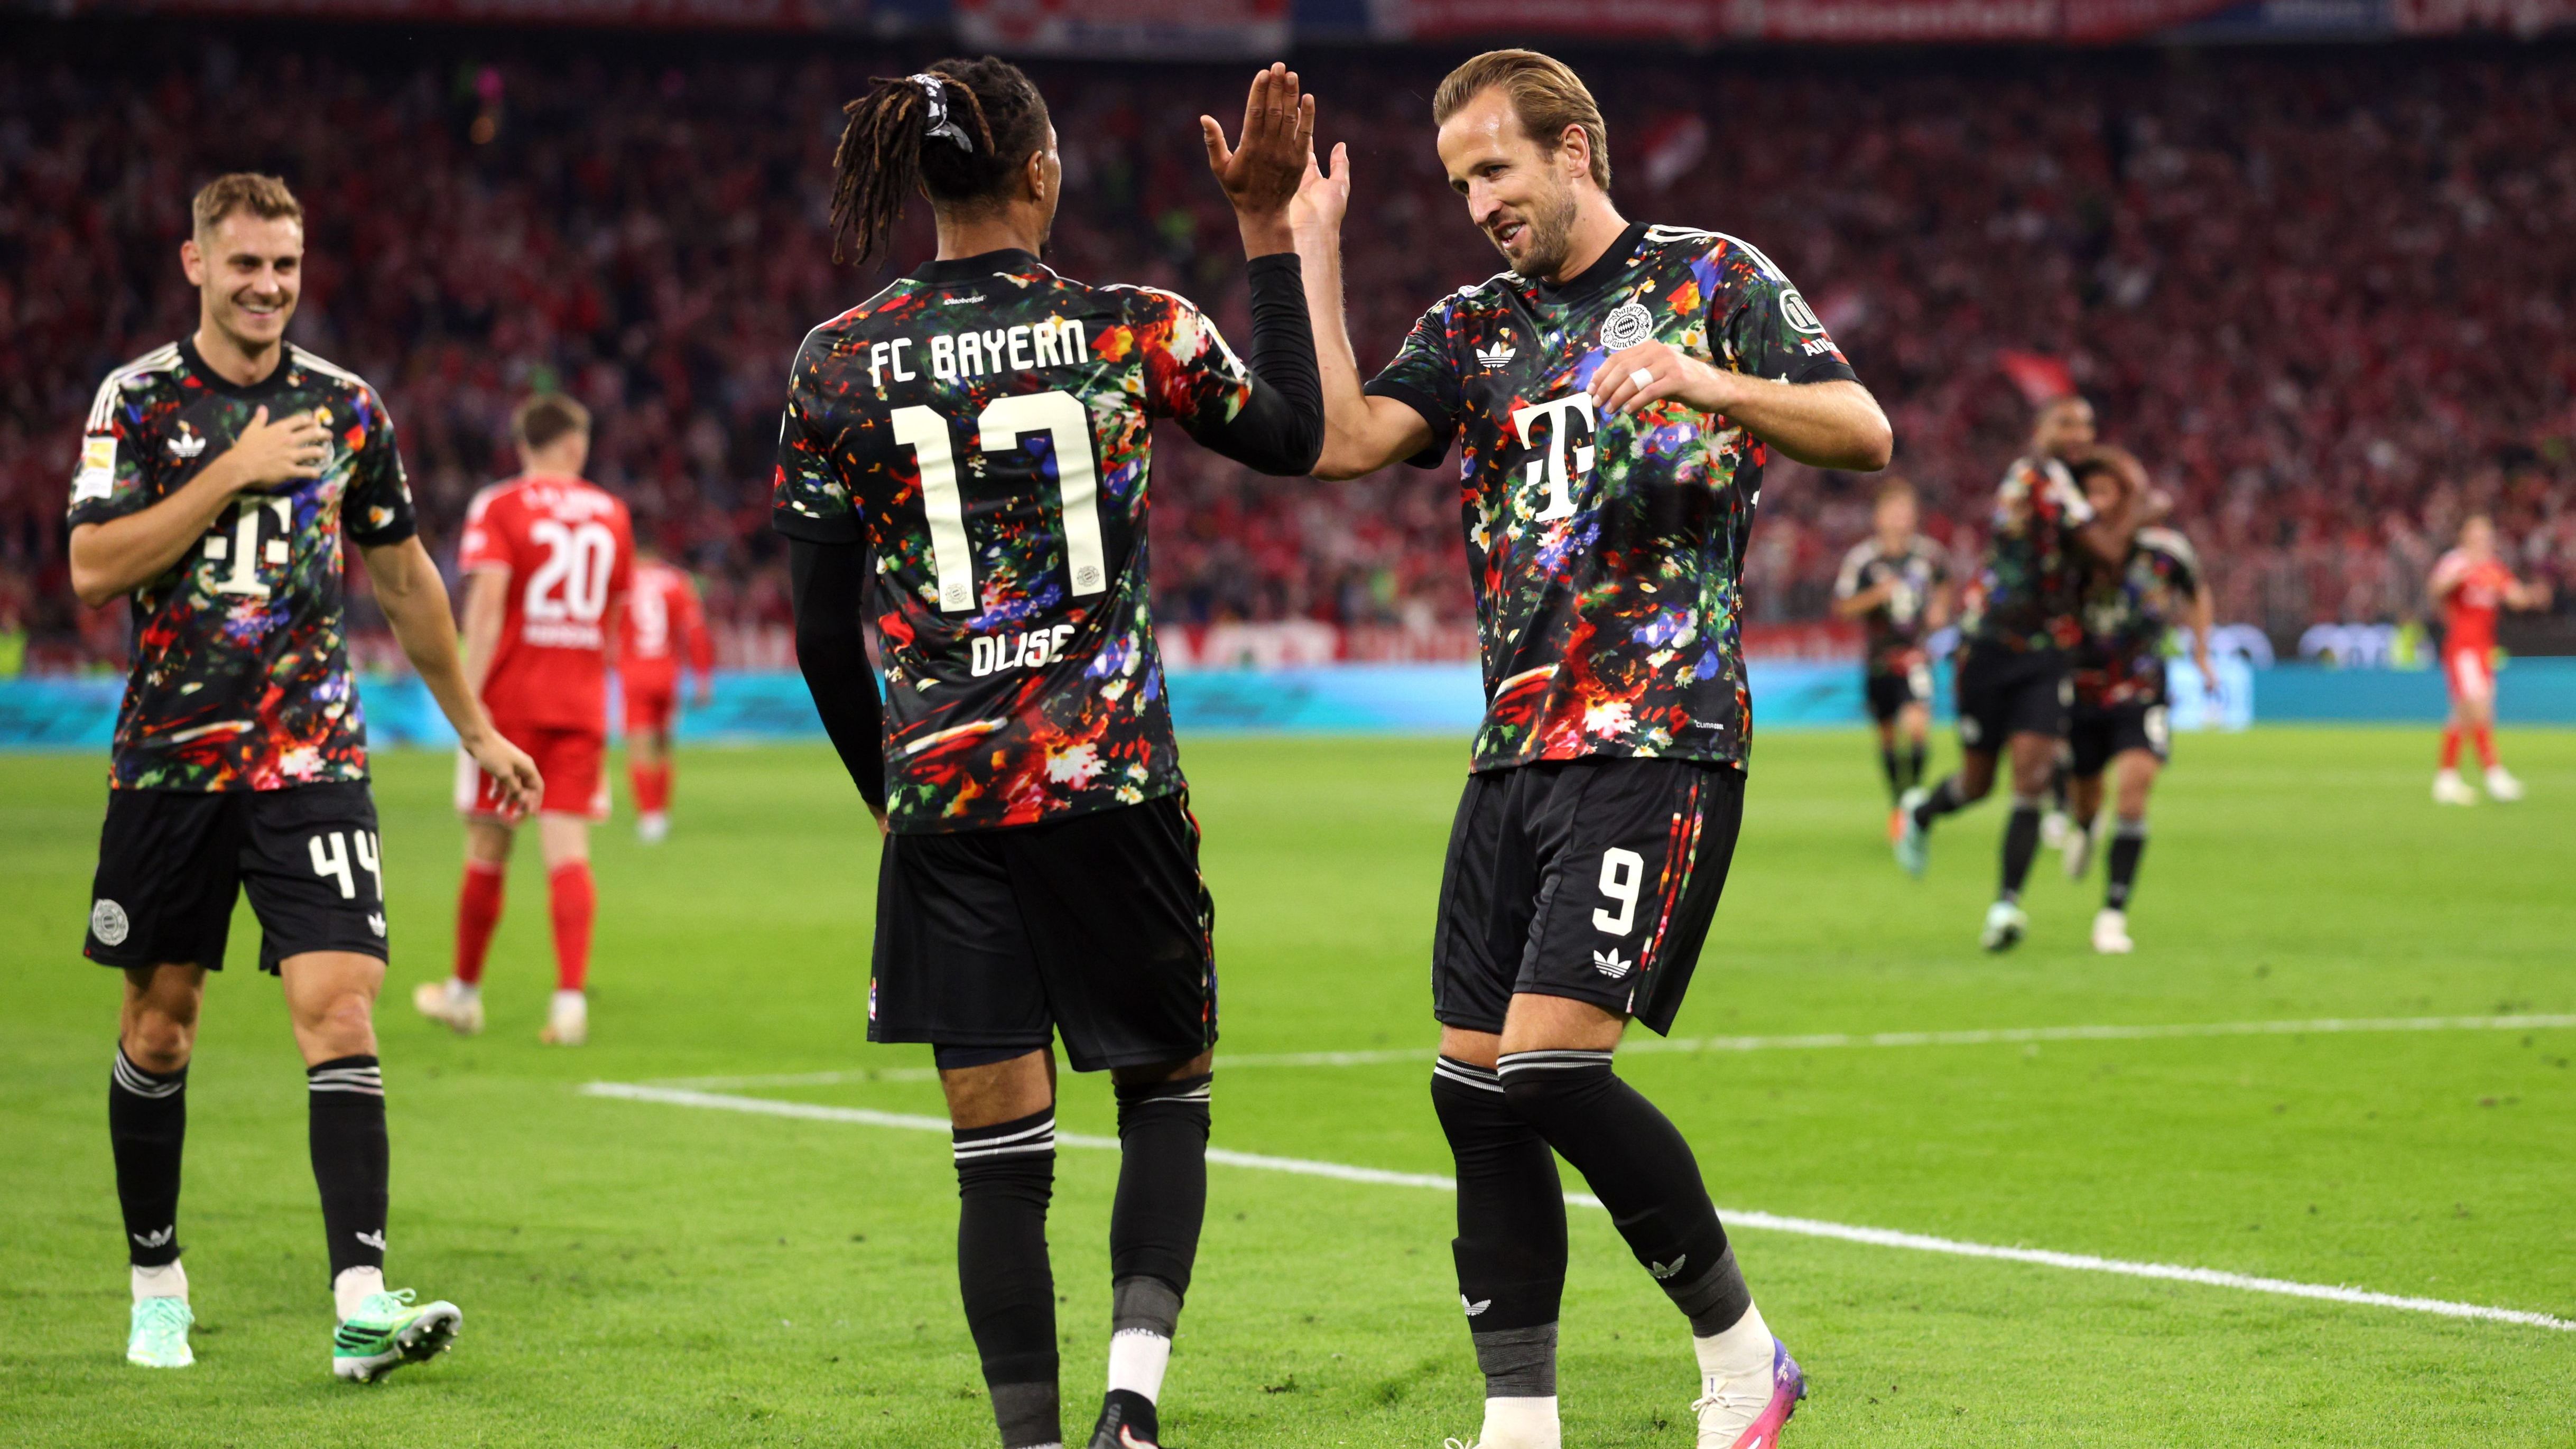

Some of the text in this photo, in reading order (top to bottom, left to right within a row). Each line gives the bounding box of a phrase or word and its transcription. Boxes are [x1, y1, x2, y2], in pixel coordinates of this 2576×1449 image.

[870, 319, 1089, 387] FC BAYERN
[891, 390, 1107, 613] 17
[1512, 392, 1595, 523] T
[526, 521, 616, 621] 20
[971, 624, 1076, 677] OLISE
[308, 829, 383, 903] 44
[1591, 847, 1644, 937] 9
